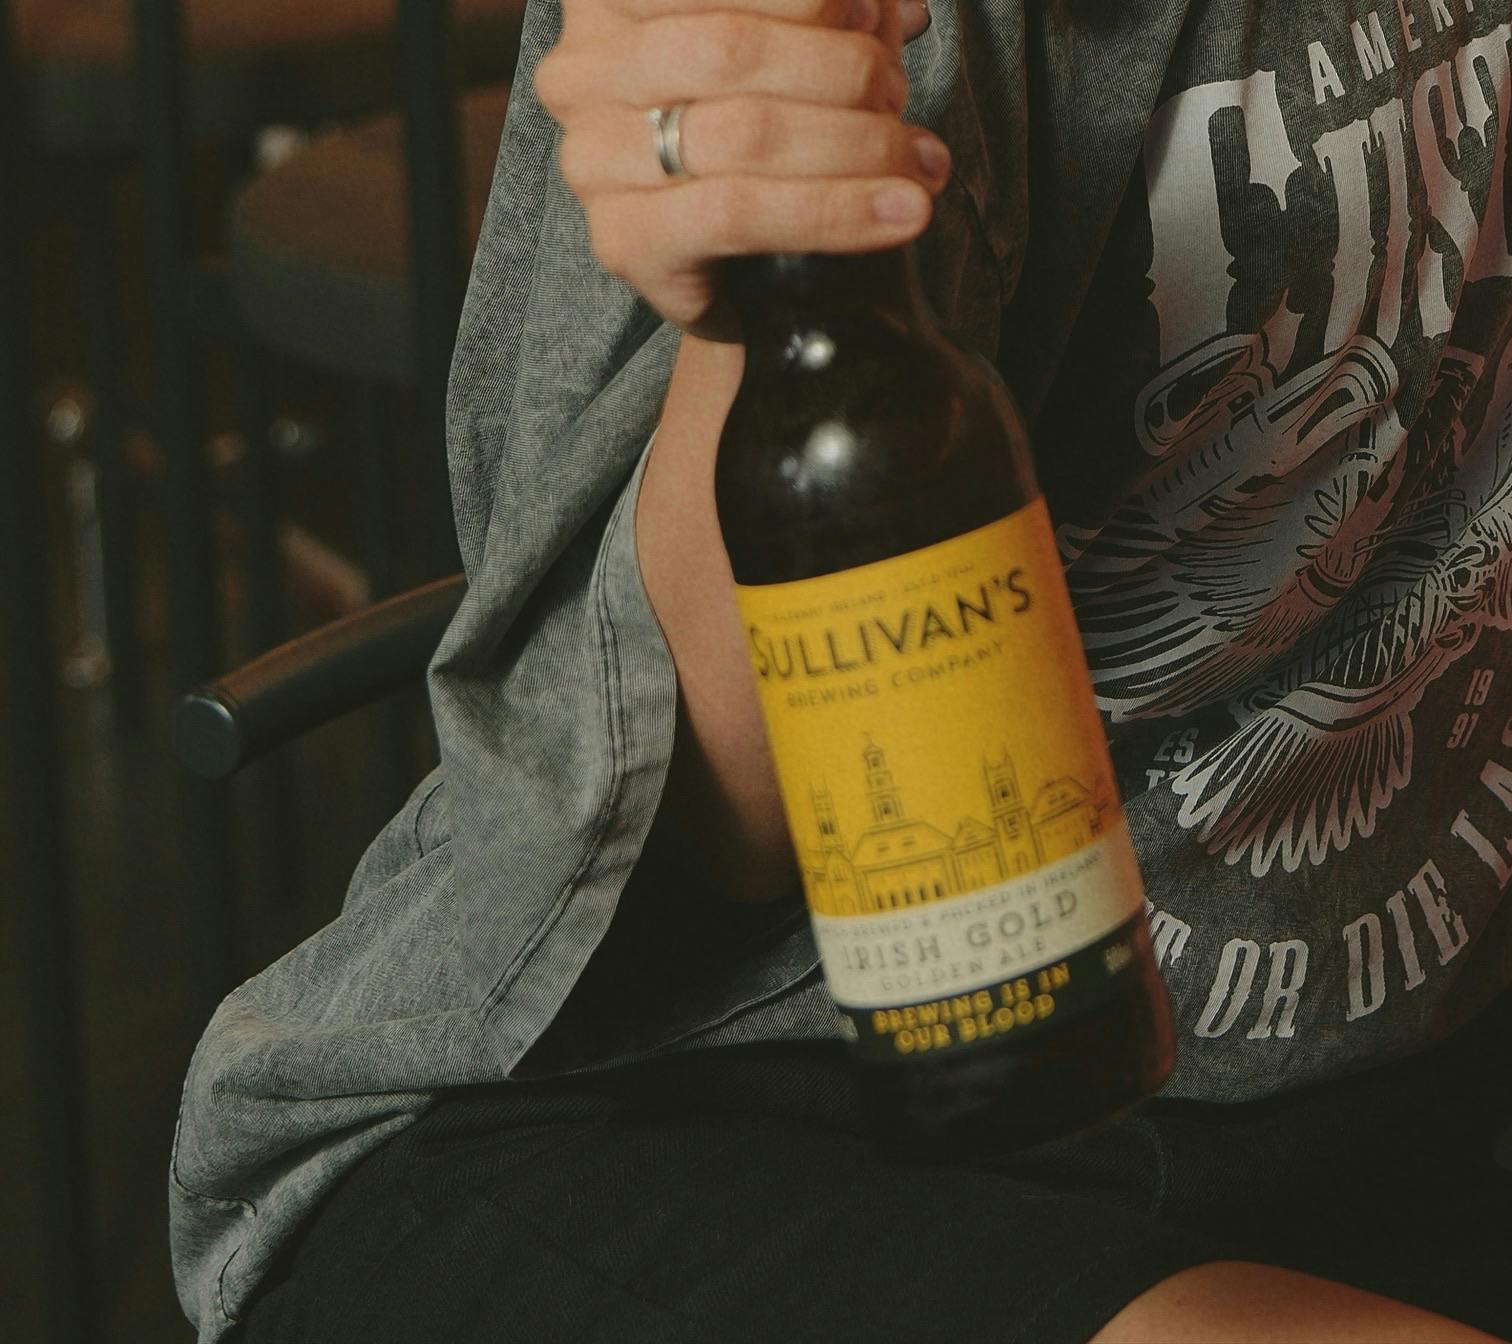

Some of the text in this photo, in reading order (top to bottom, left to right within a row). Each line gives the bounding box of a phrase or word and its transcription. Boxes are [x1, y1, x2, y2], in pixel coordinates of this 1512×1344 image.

[749, 567, 1032, 680] SULLIVAN'S
[787, 639, 1004, 709] BREWING COMPANY
[1464, 668, 1496, 706] 19
[1446, 713, 1477, 750] 91
[842, 888, 1079, 972] IRISH GOLD
[880, 934, 1049, 993] GOLDEN ALE
[1194, 938, 1310, 1040] OR
[1343, 859, 1469, 1022] DIE
[871, 962, 1072, 1035] BREWING IS IN
[894, 993, 1057, 1055] OUR BLOOD
